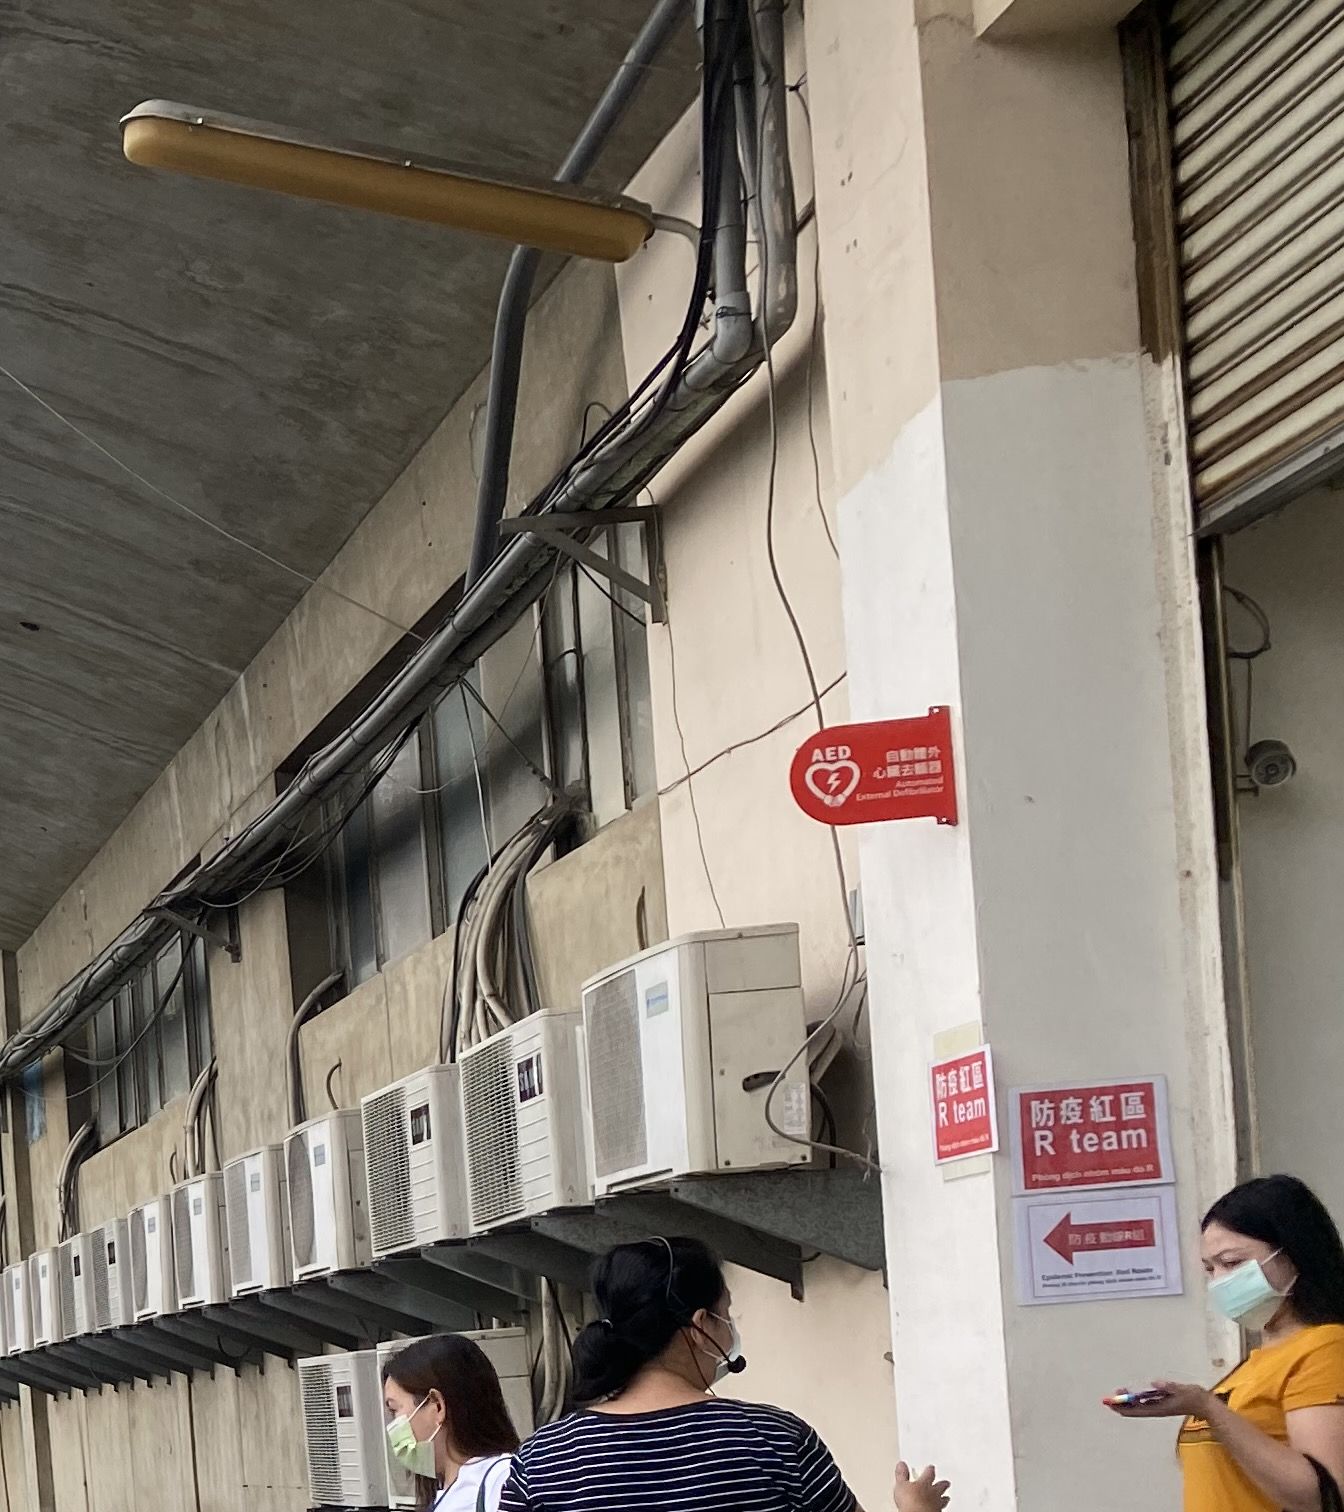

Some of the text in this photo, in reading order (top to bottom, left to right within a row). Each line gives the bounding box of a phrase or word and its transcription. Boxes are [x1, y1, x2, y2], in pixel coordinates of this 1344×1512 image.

[812, 745, 852, 762] AED
[935, 1060, 985, 1100] 防疫紅區
[938, 1097, 987, 1129] R team
[1030, 1090, 1147, 1129] 防疫紅區
[1034, 1128, 1148, 1157] R team
